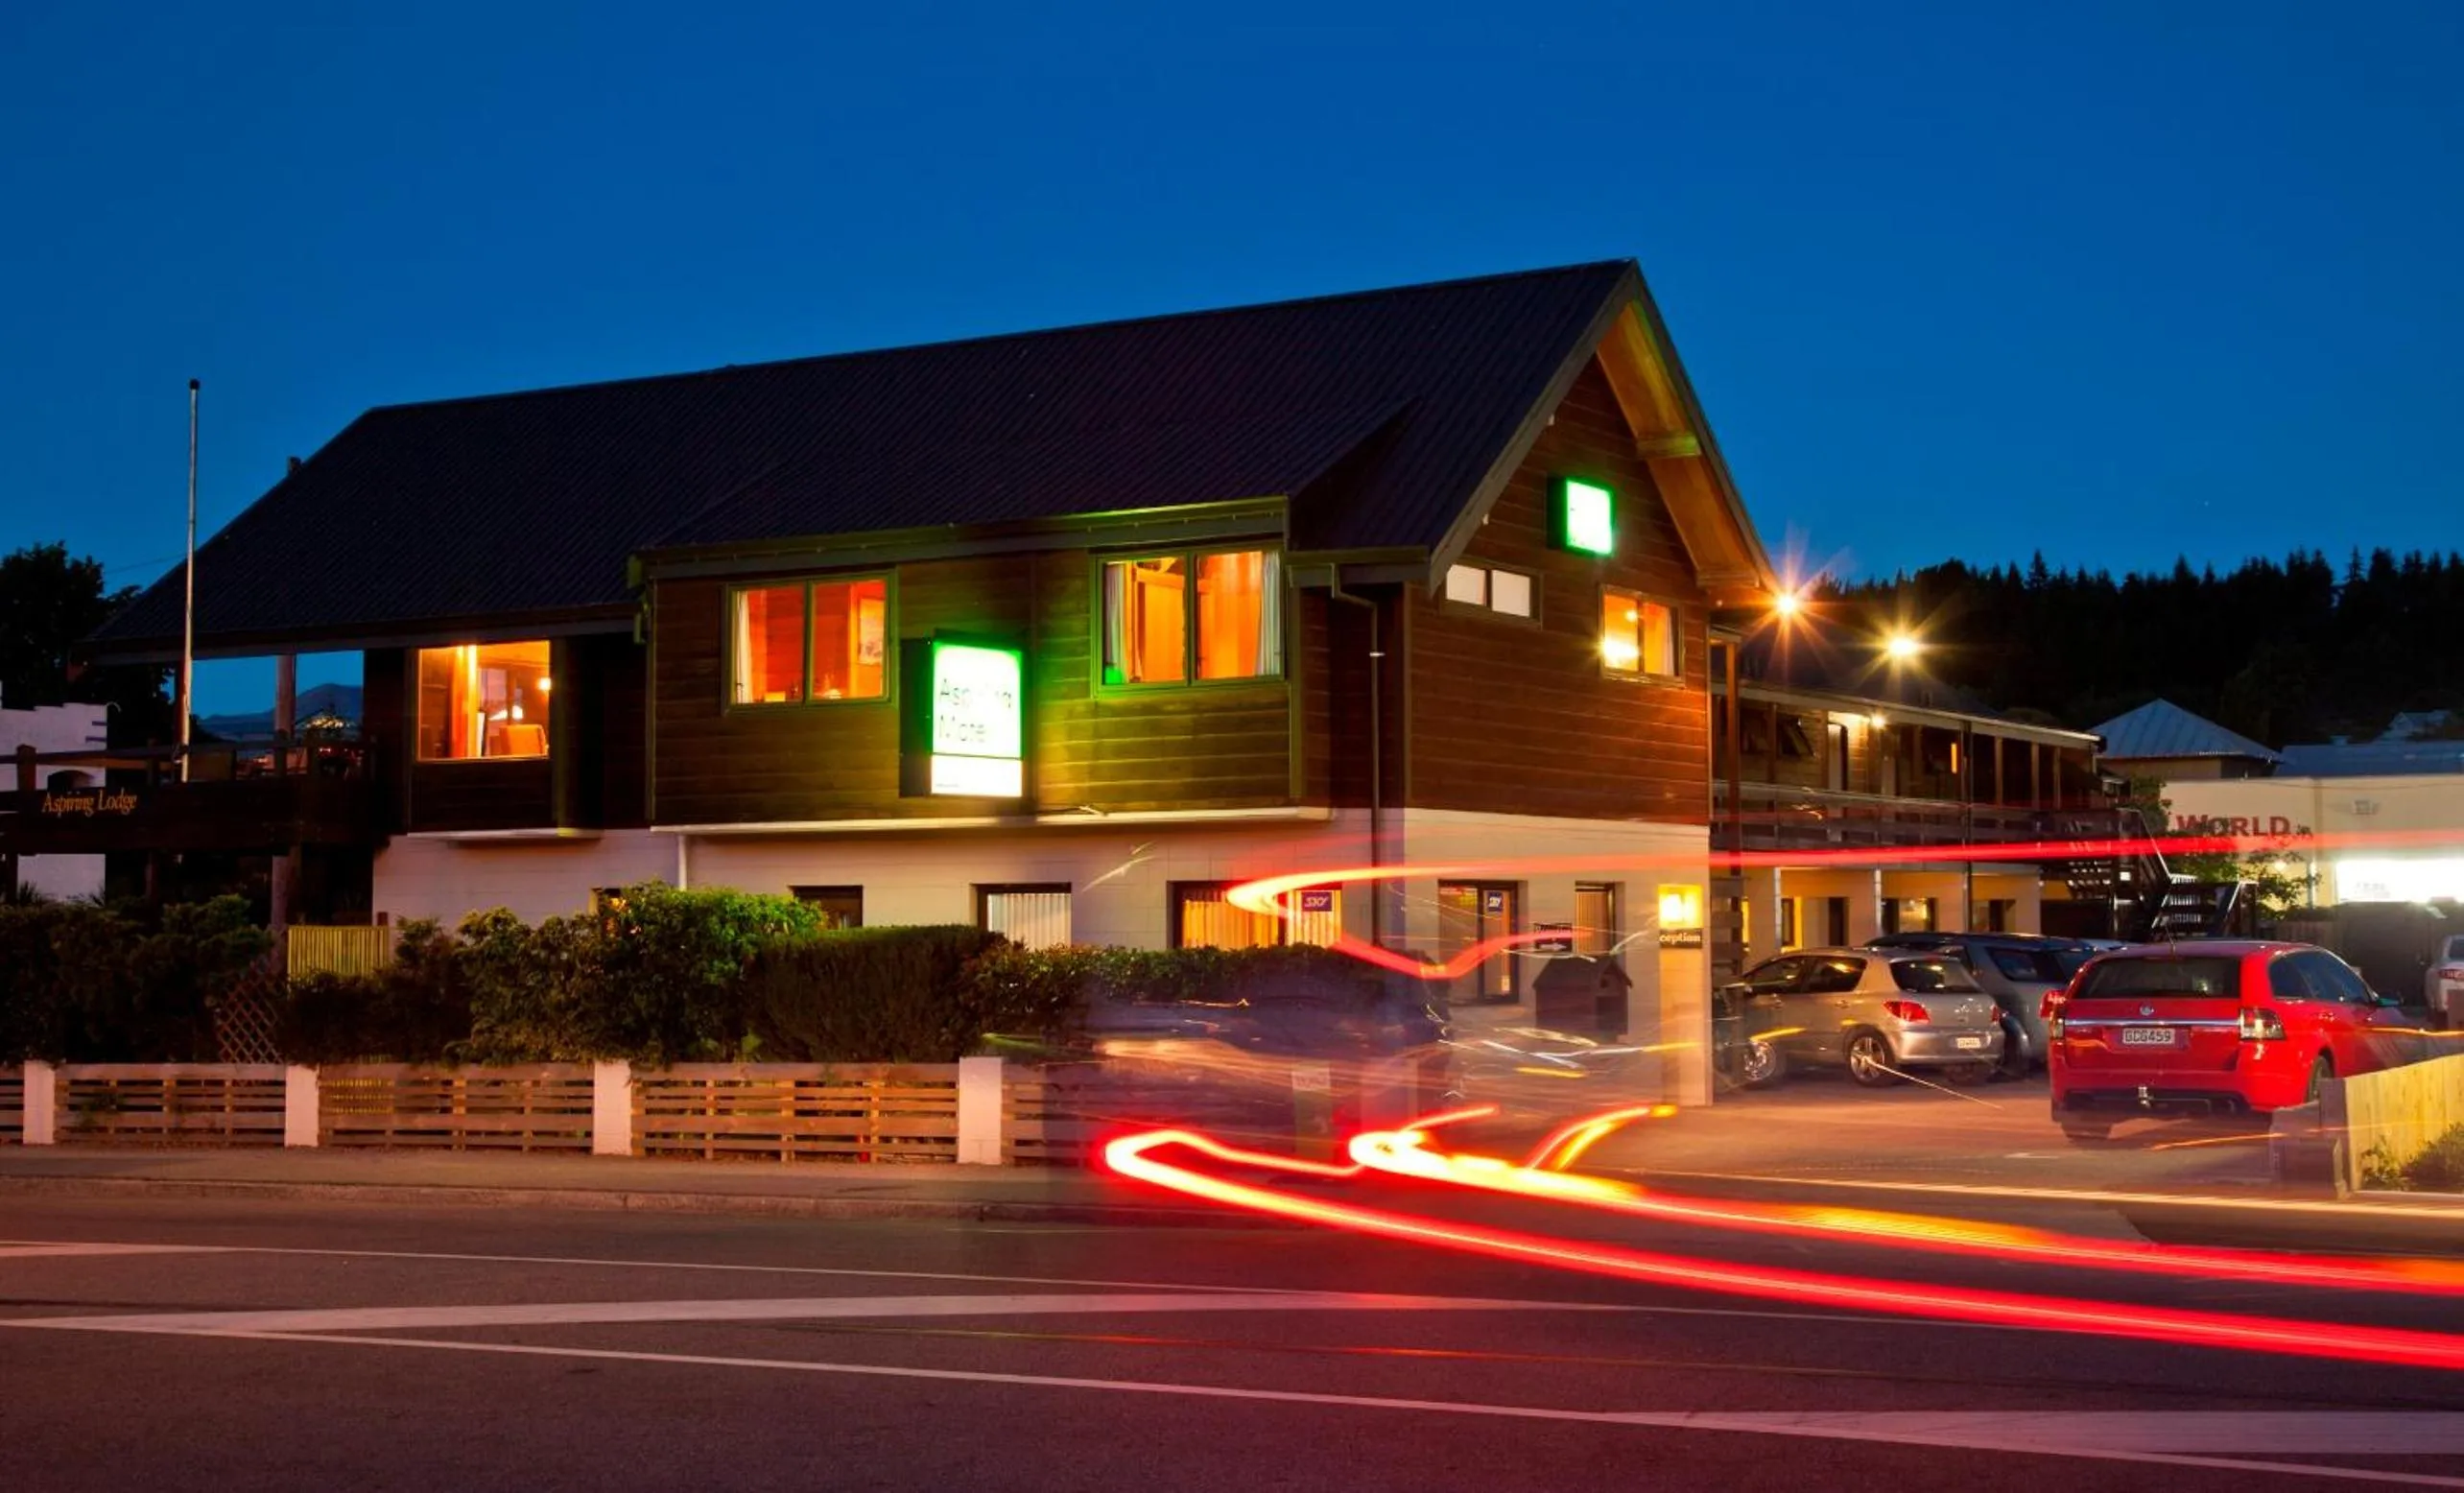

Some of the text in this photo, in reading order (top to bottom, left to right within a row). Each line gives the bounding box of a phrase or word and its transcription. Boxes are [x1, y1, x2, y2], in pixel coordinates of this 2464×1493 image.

[41, 787, 137, 818] Aspiring Lodge
[2175, 814, 2290, 837] WORLD
